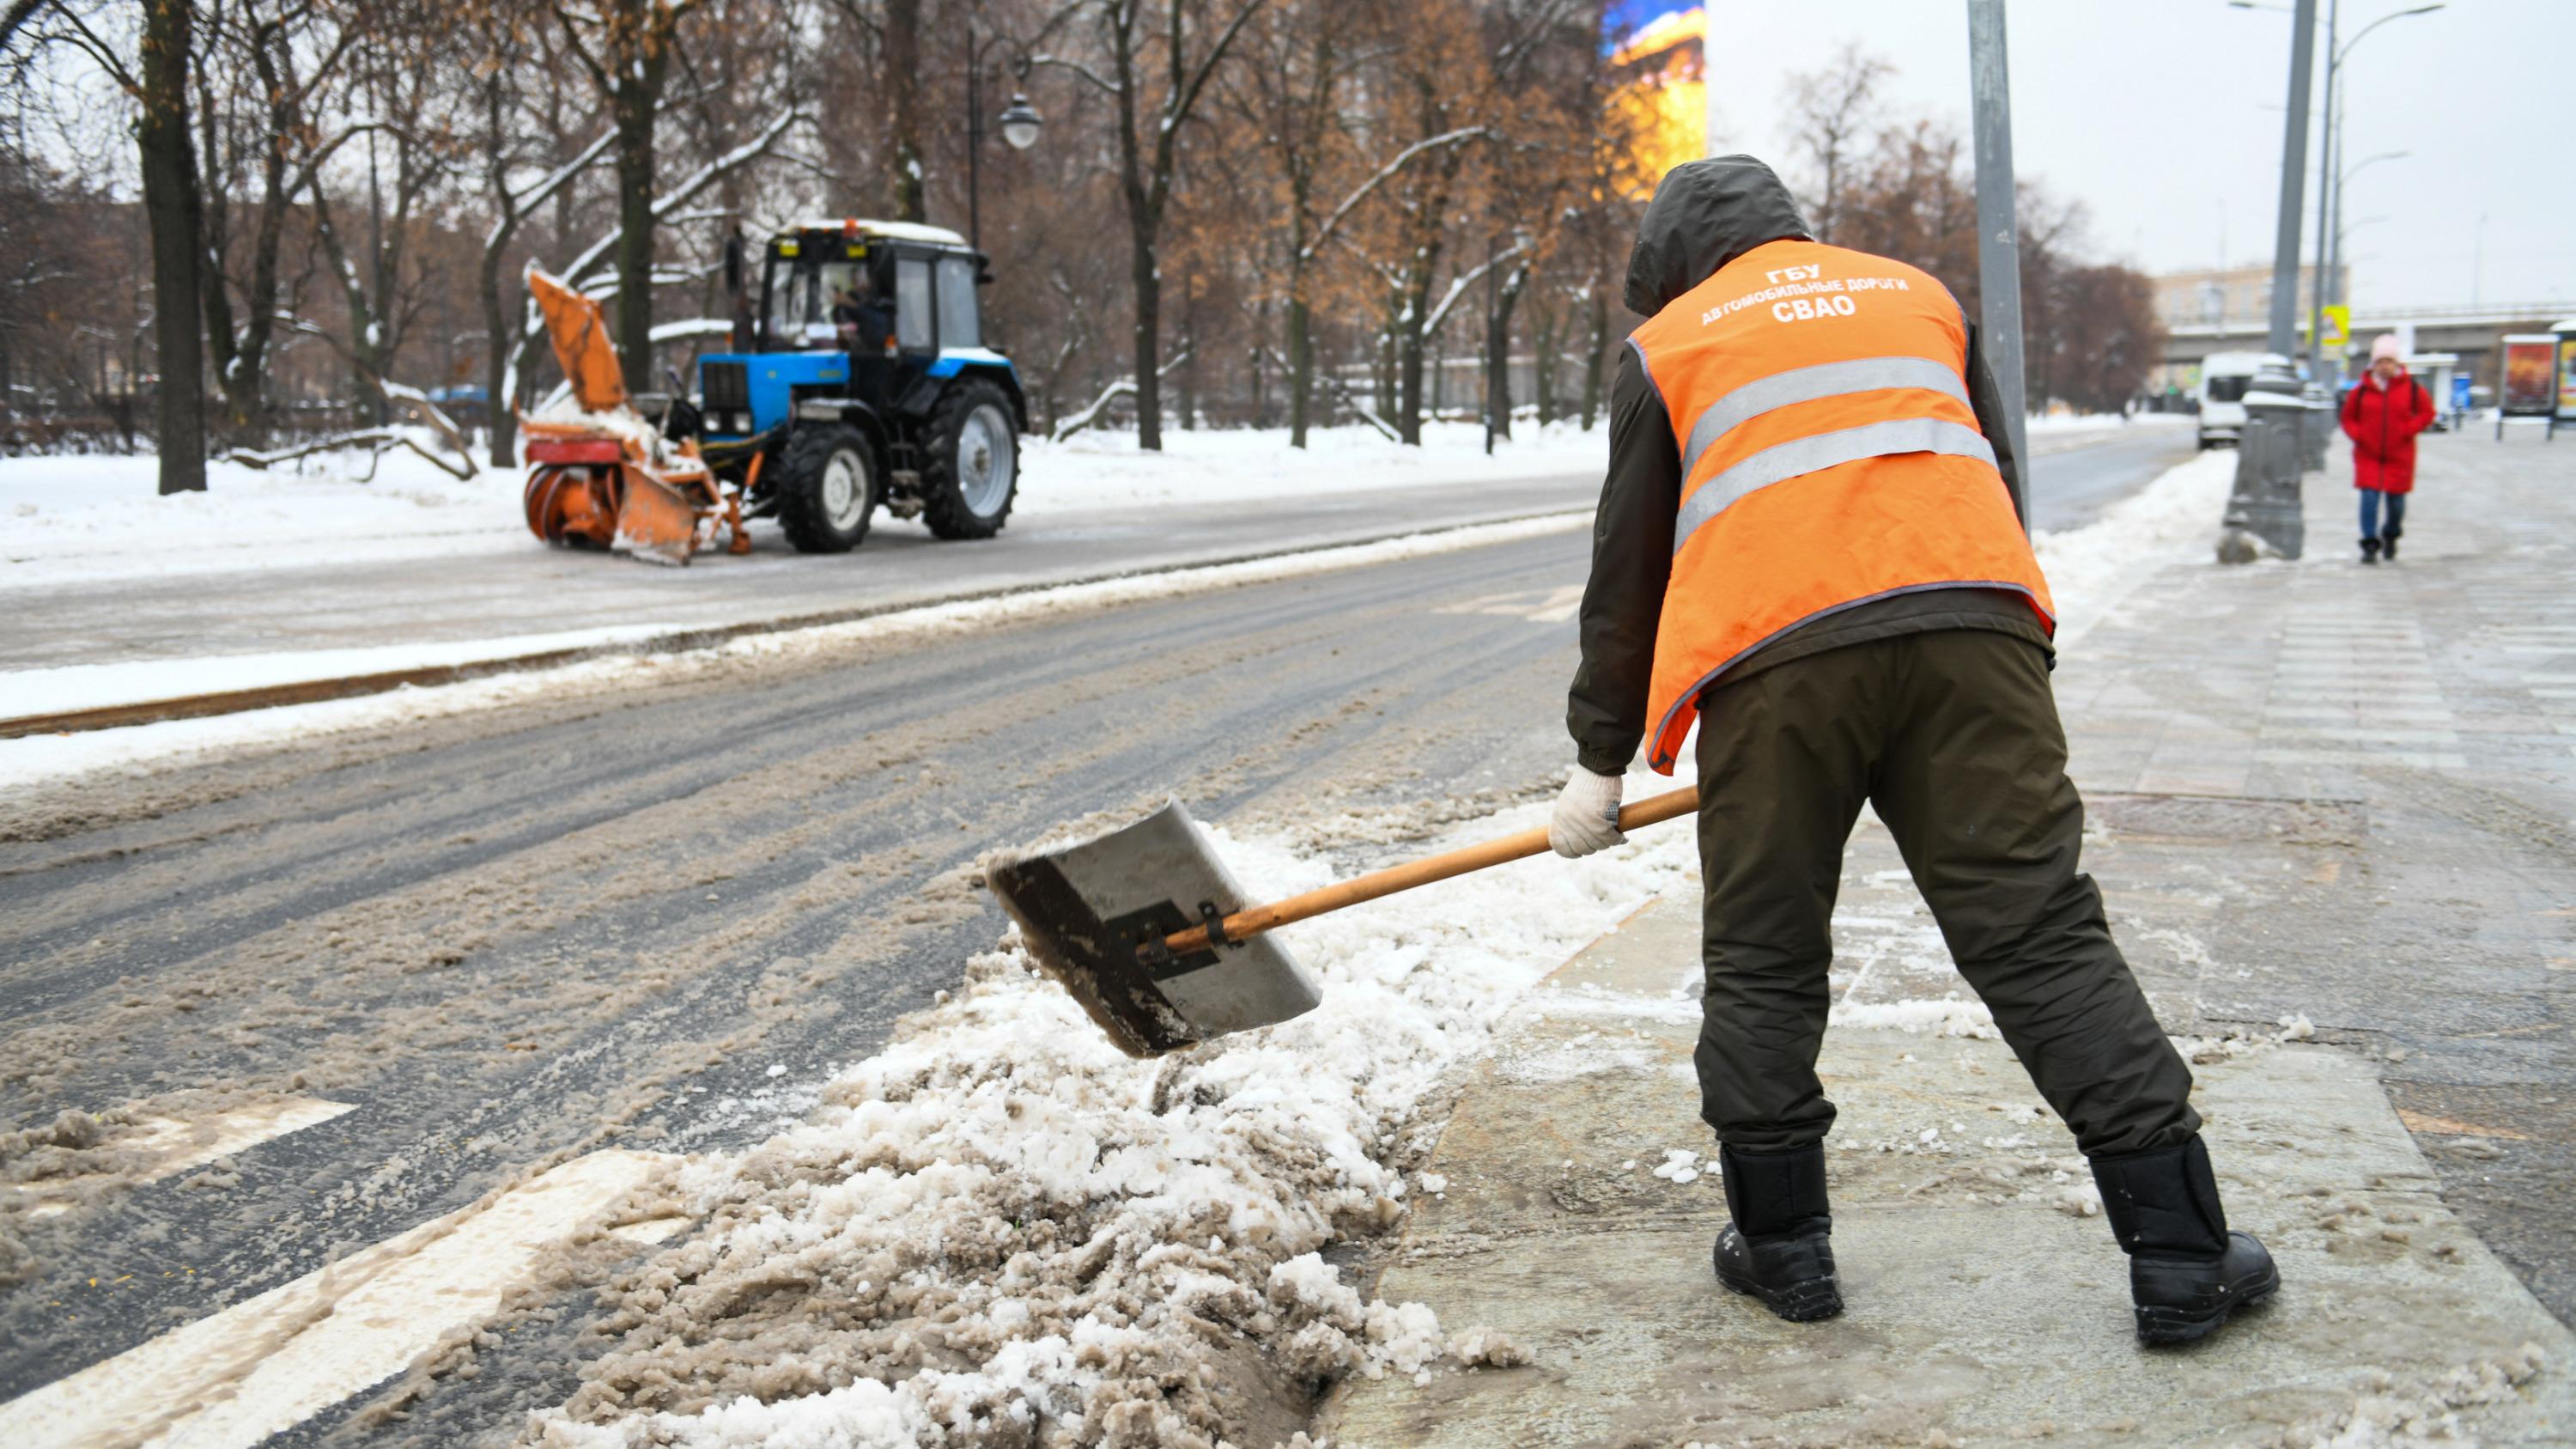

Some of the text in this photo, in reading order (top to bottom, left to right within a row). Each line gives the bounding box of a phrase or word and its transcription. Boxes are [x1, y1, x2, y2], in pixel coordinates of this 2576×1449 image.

[1765, 264, 1820, 284] ГБУ
[1701, 277, 1910, 326] АВТОМОБИЛЬНЫЕ ДОРОГИ
[1771, 295, 1856, 323] СВАО
